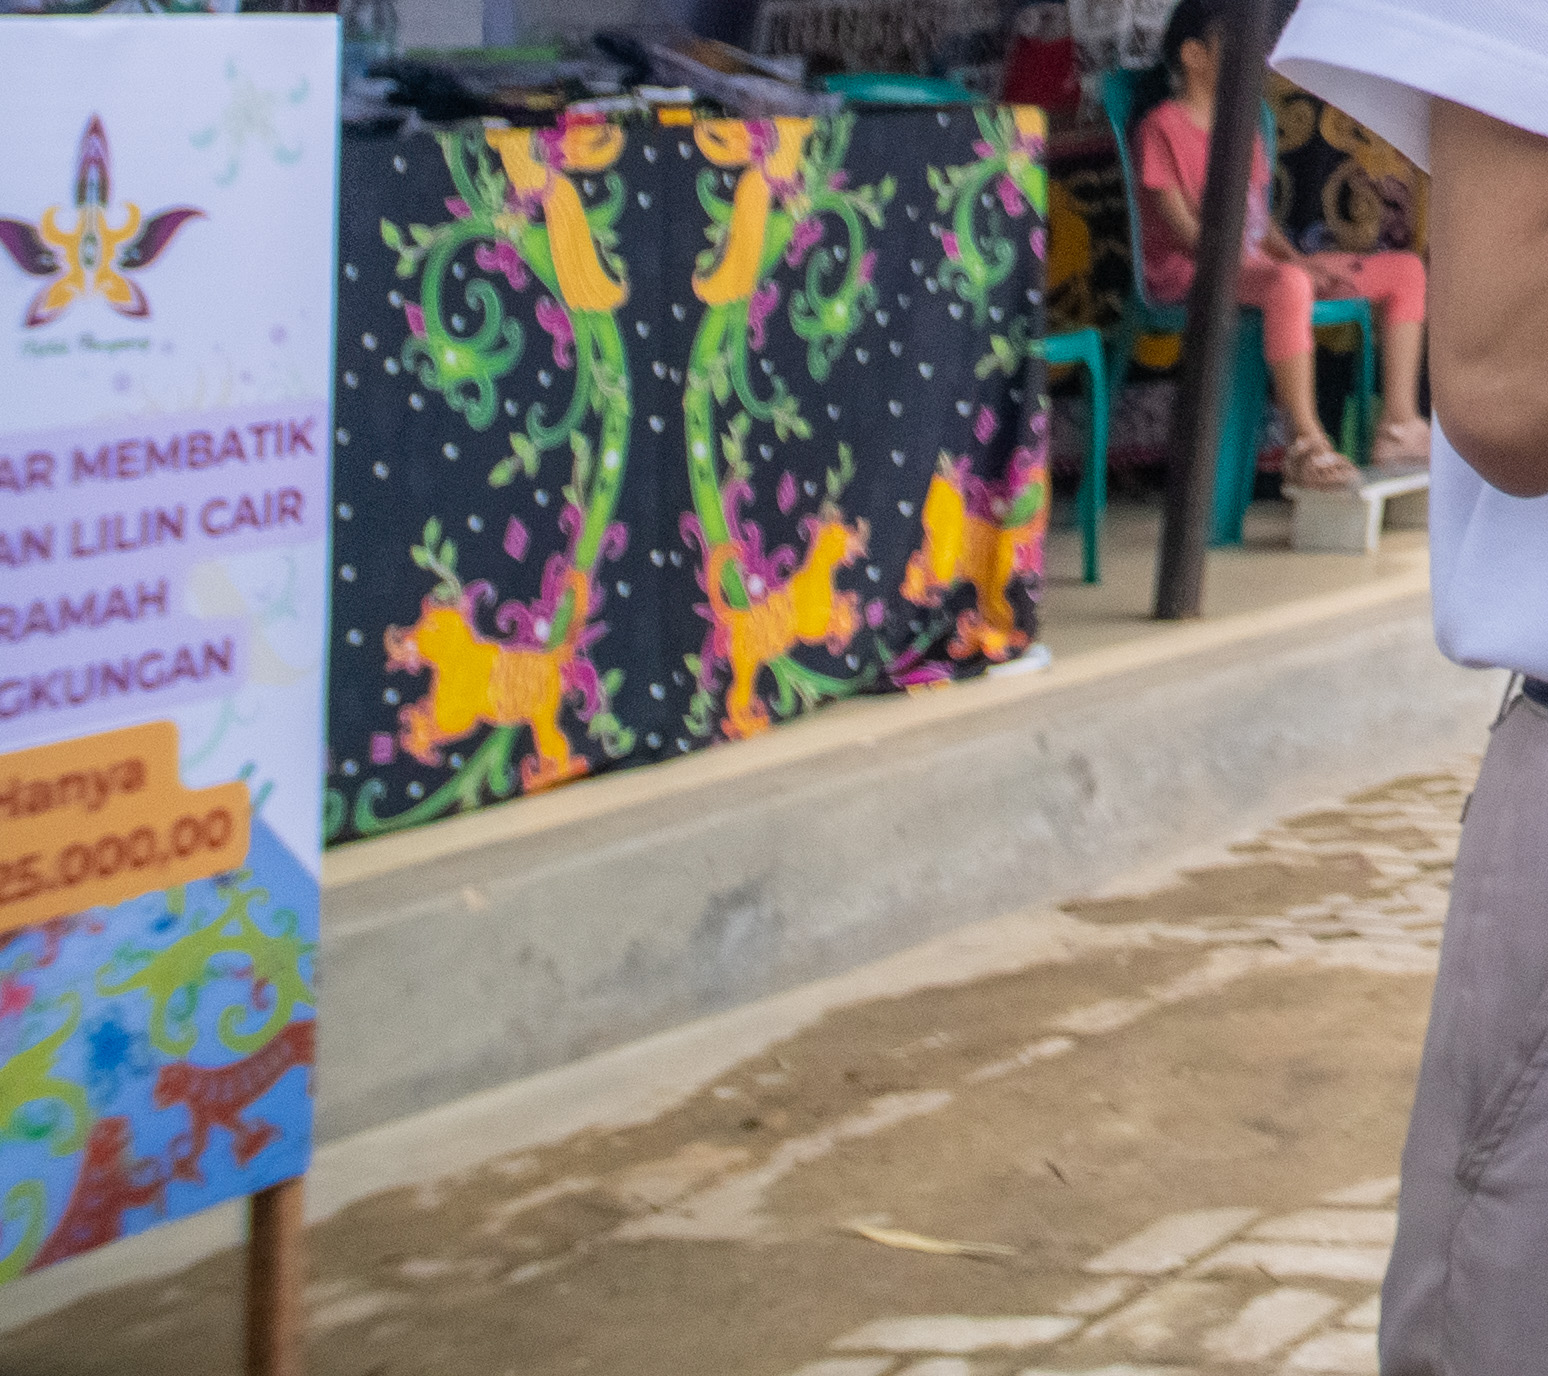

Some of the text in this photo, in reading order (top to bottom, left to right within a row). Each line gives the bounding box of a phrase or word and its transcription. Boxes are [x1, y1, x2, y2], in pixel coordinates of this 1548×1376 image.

[0, 417, 315, 493] AR MEMBATIK
[70, 505, 185, 559] LILIN
[200, 488, 303, 537] CAIR
[0, 637, 233, 719] GKUNGAN
